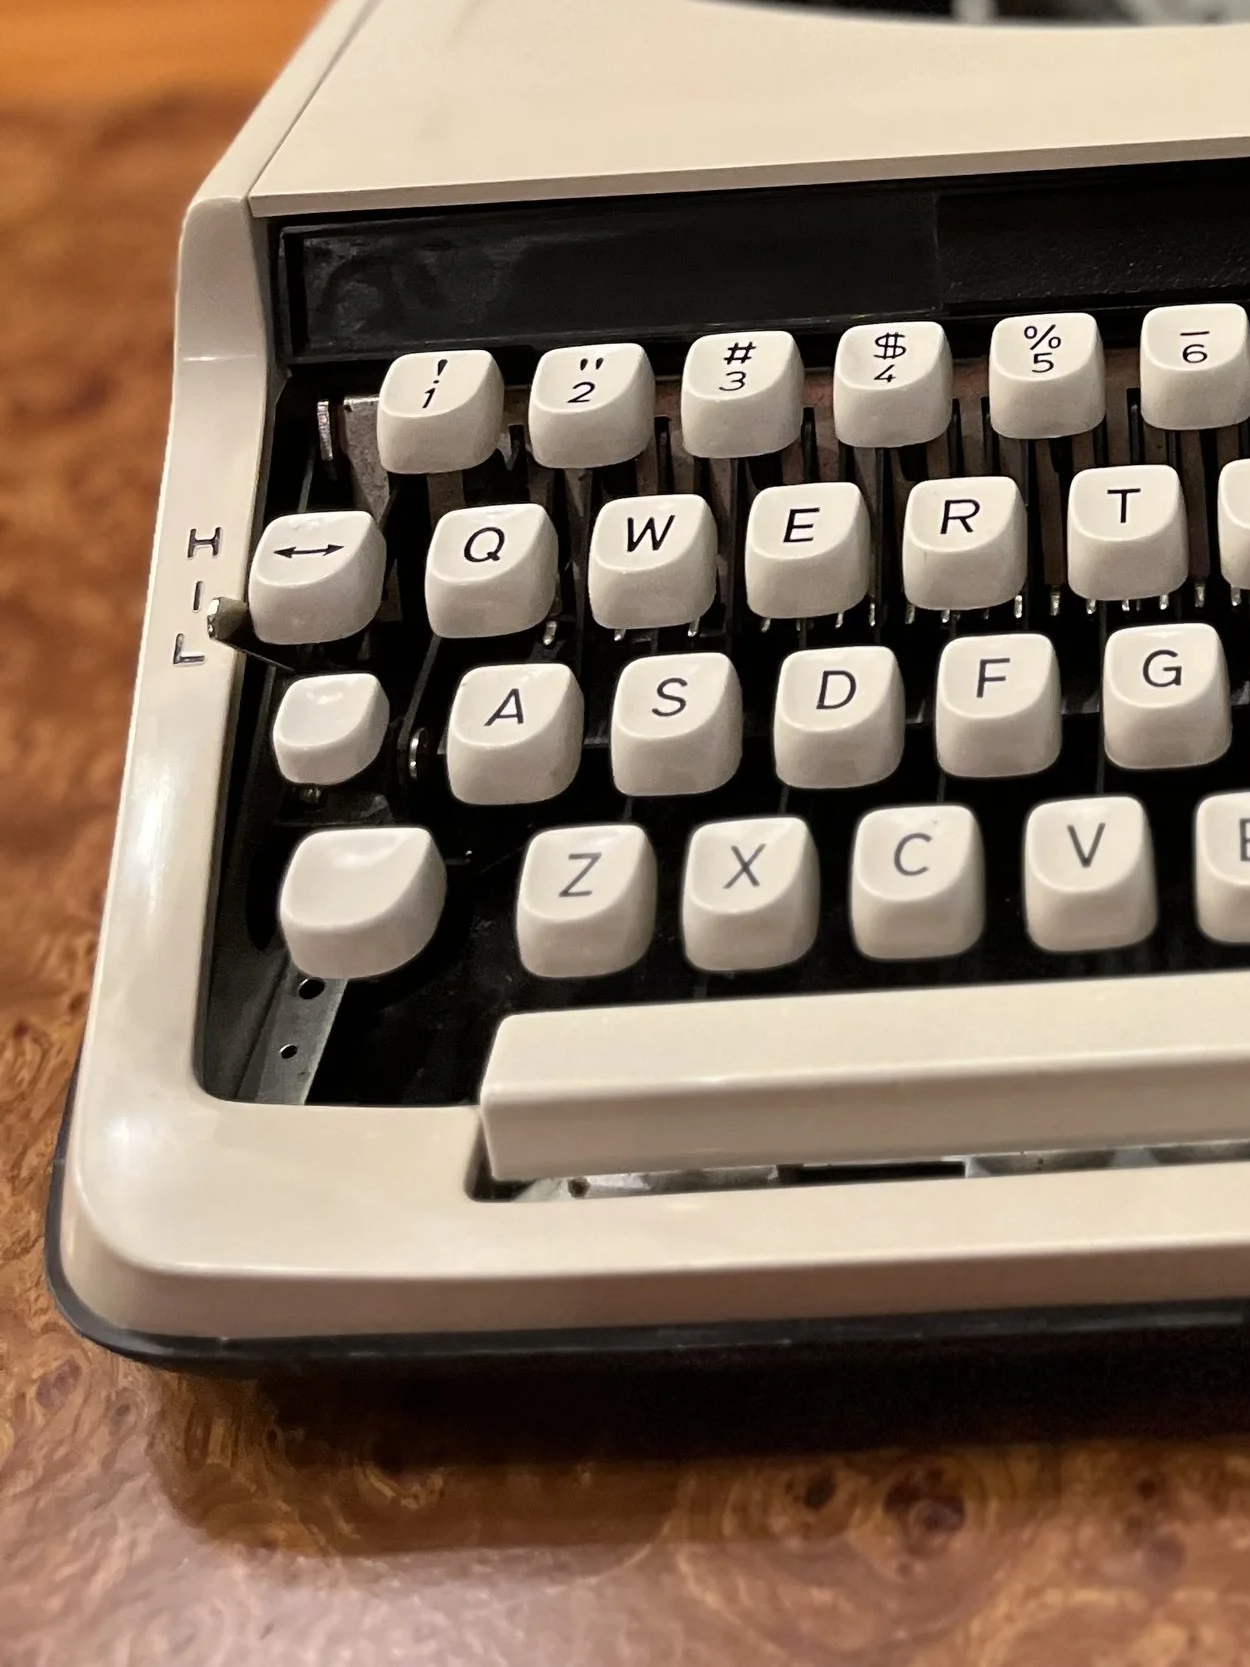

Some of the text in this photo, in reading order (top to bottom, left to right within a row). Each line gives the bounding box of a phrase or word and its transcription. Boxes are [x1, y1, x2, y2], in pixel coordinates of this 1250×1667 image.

[723, 341, 757, 365] #
[873, 332, 907, 361] $
[1023, 324, 1062, 351] %
[1182, 343, 1208, 364] 6
[432, 359, 448, 384] !
[873, 364, 896, 383] 4
[1031, 352, 1055, 374] 5
[422, 387, 436, 409] 1
[567, 381, 596, 404] 2
[718, 371, 747, 392] 3
[940, 499, 981, 535] R
[1107, 488, 1141, 524] T
[187, 526, 221, 559] H
[626, 514, 676, 553] W
[782, 507, 820, 543] E
[463, 526, 505, 563] Q
[192, 580, 203, 611] I
[172, 633, 205, 665] L
[976, 657, 1011, 698] F
[1142, 649, 1182, 688] G
[484, 688, 524, 727] A
[651, 677, 688, 717] S
[816, 670, 857, 710] D
[893, 832, 932, 876] C
[1067, 823, 1105, 868] V
[558, 852, 601, 899] Z
[724, 845, 764, 890] X
